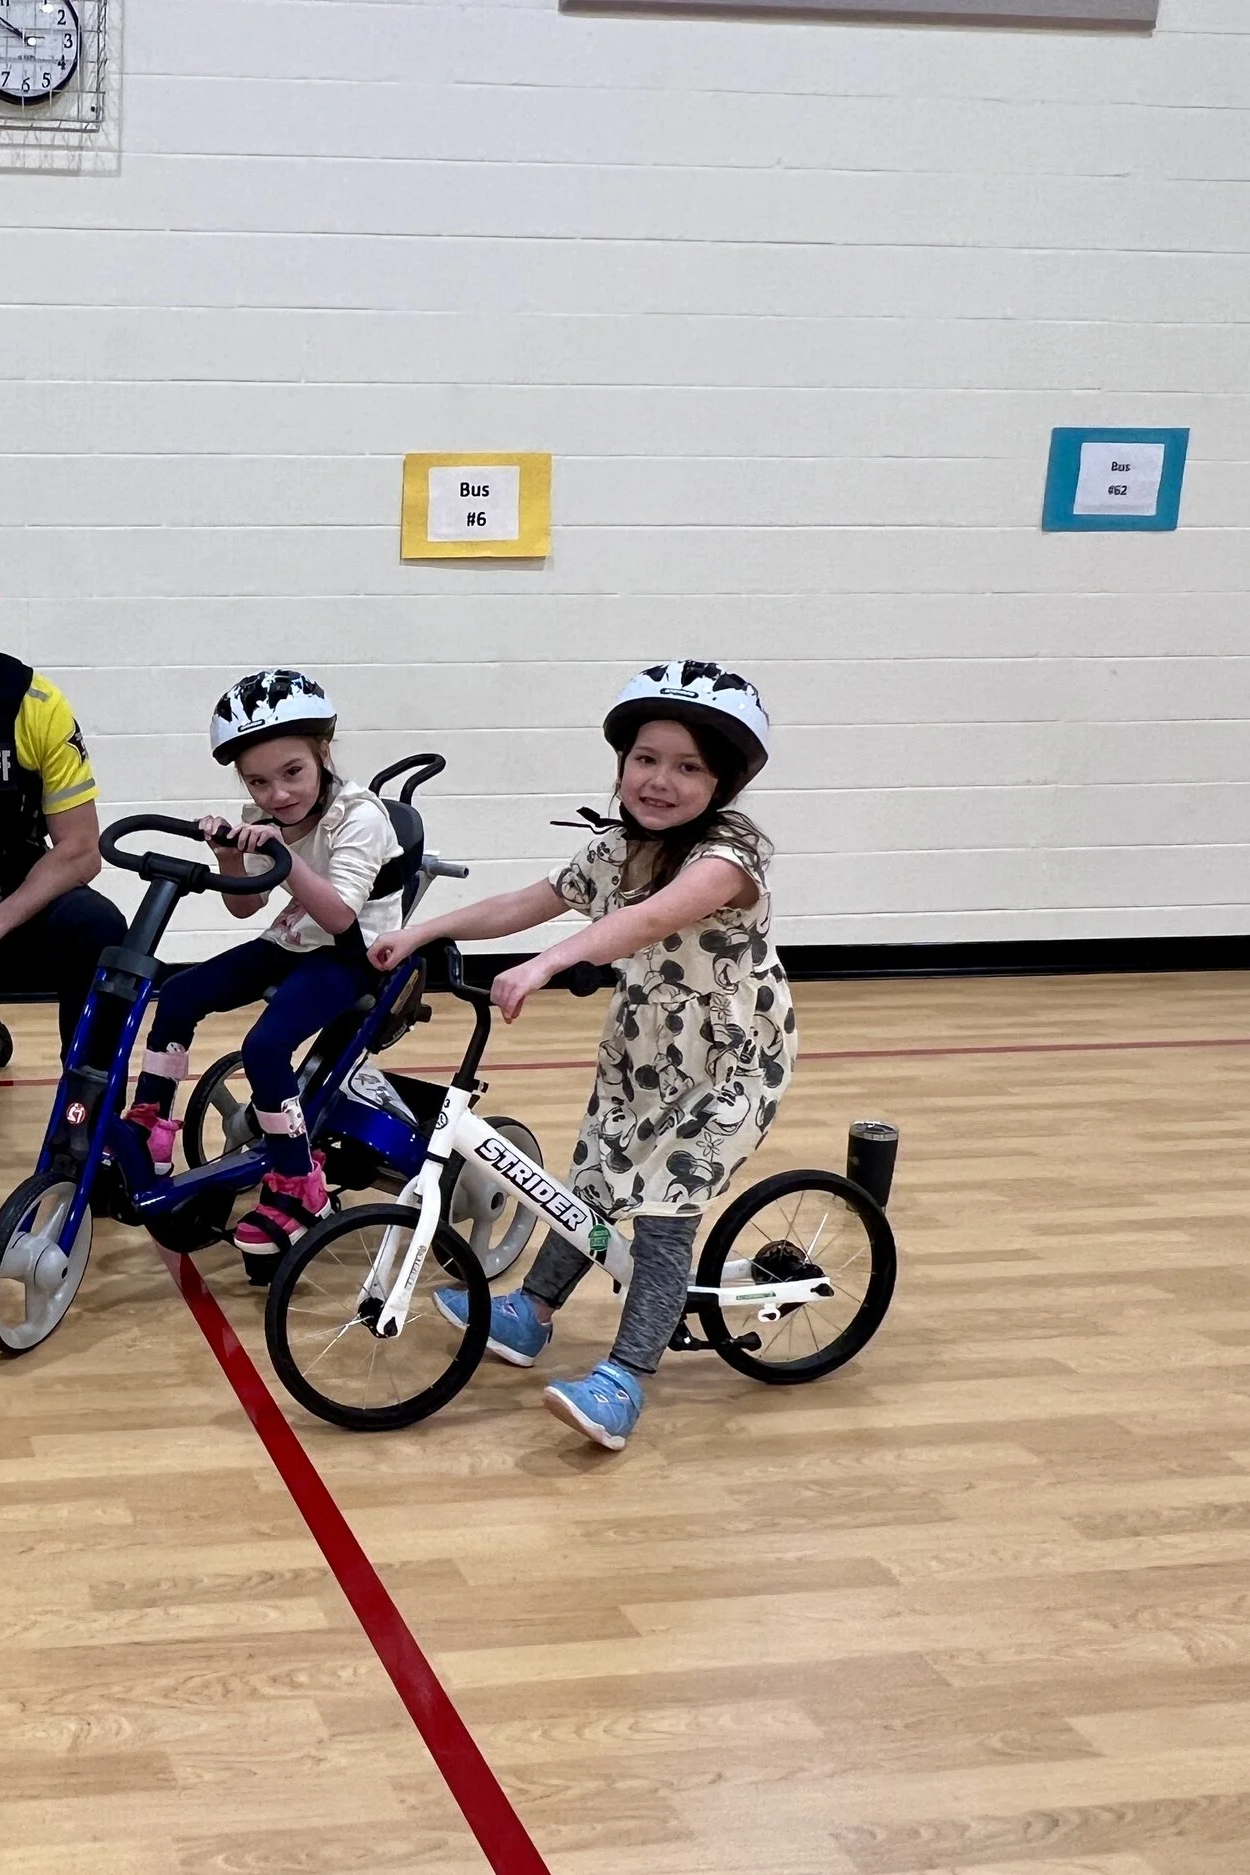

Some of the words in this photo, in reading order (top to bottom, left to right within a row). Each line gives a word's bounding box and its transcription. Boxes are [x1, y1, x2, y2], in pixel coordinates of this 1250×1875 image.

[56, 9, 67, 25] 2
[64, 33, 74, 48] 3
[57, 55, 67, 70] 4
[1, 71, 11, 87] 7
[21, 77, 31, 93] 6
[41, 72, 51, 88] 5
[1110, 461, 1131, 472] Bus
[460, 482, 490, 497] Bus
[1108, 485, 1128, 496] #62
[467, 512, 487, 527] #6
[474, 1138, 588, 1232] STRIDER
